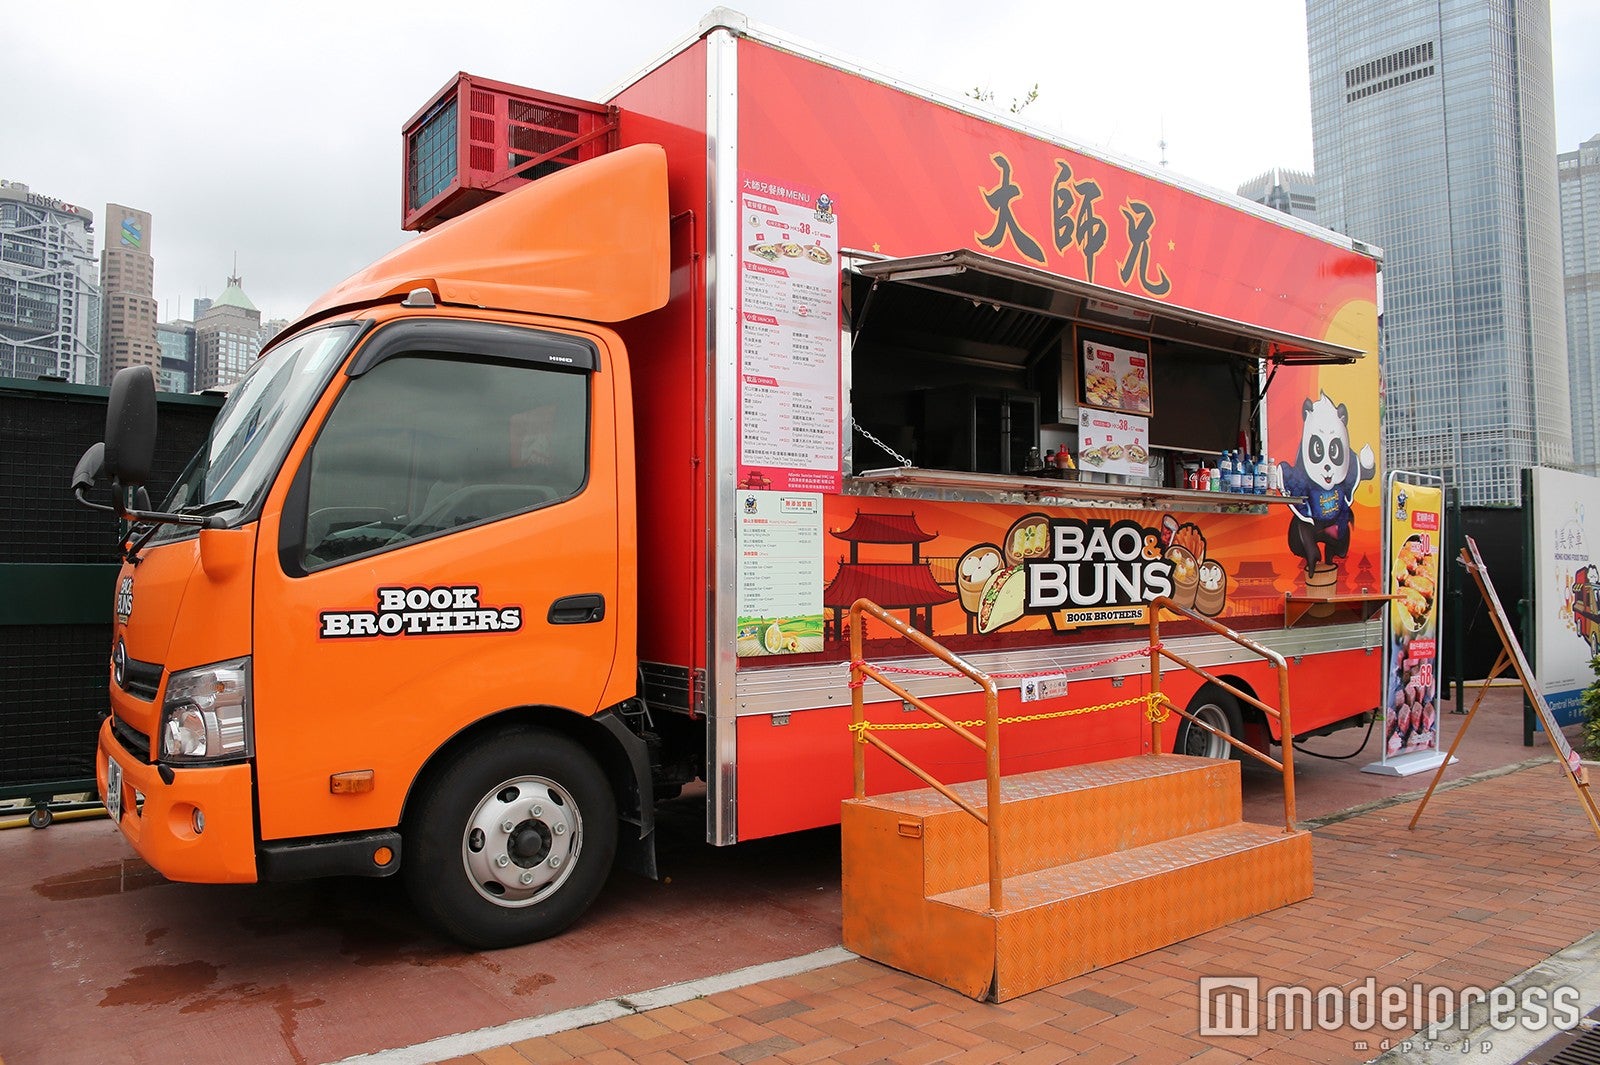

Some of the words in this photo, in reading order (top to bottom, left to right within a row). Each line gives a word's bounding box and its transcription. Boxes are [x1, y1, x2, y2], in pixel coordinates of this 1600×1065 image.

[26, 193, 60, 209] HSBC
[974, 151, 1171, 297] 大師兄
[549, 355, 573, 363] HINO
[1053, 526, 1142, 562] BAO
[1029, 562, 1172, 608] BUNS
[380, 588, 478, 611] BOOK
[322, 609, 521, 636] BROTHERS
[1066, 611, 1094, 622] BOOK
[1094, 609, 1143, 621] BROTHERS
